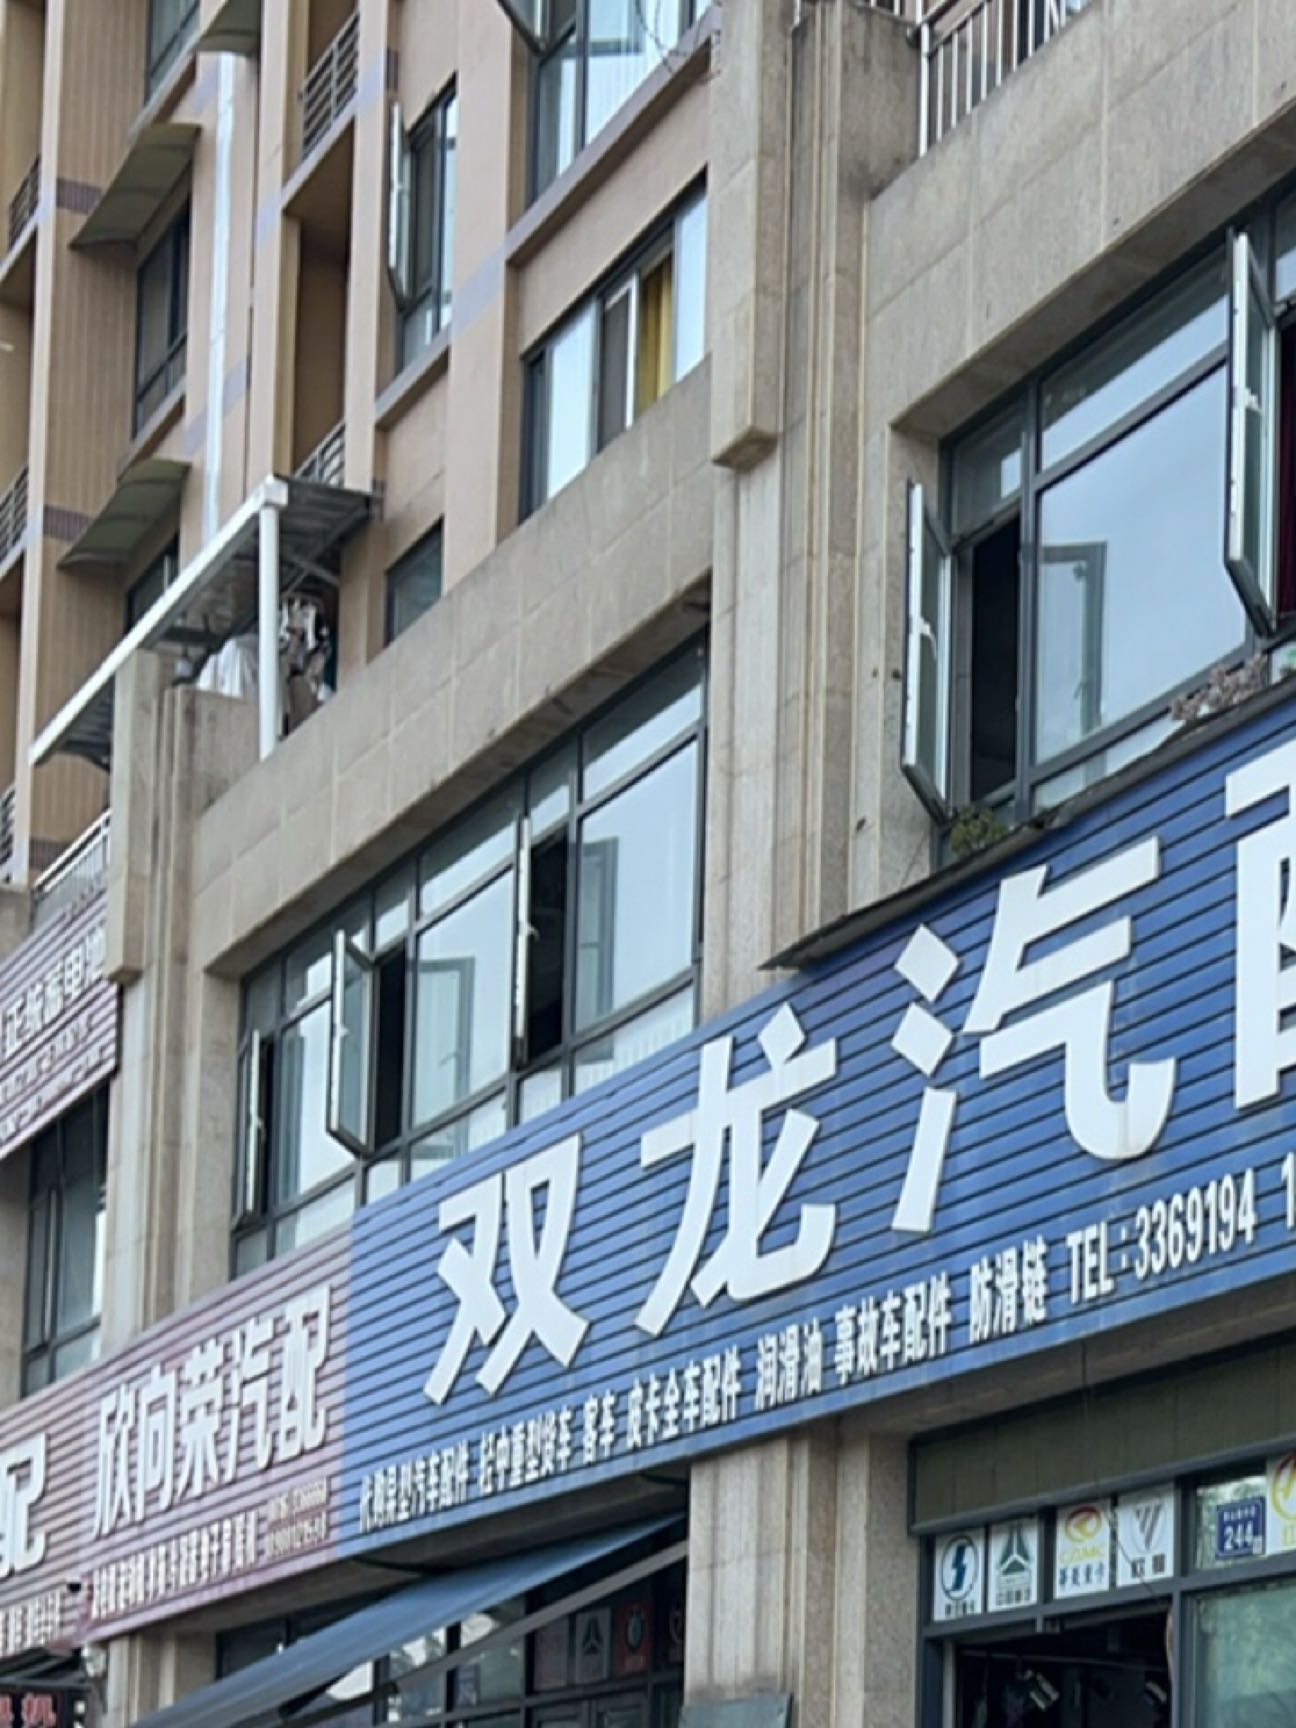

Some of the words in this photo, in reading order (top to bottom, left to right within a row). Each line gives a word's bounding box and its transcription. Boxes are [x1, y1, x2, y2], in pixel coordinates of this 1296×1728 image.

[93, 1285, 331, 1539] 欣向荣汽配
[756, 1316, 824, 1411] 润滑油
[834, 1271, 952, 1386] 事故车配件
[969, 1234, 1048, 1345] 防滑链
